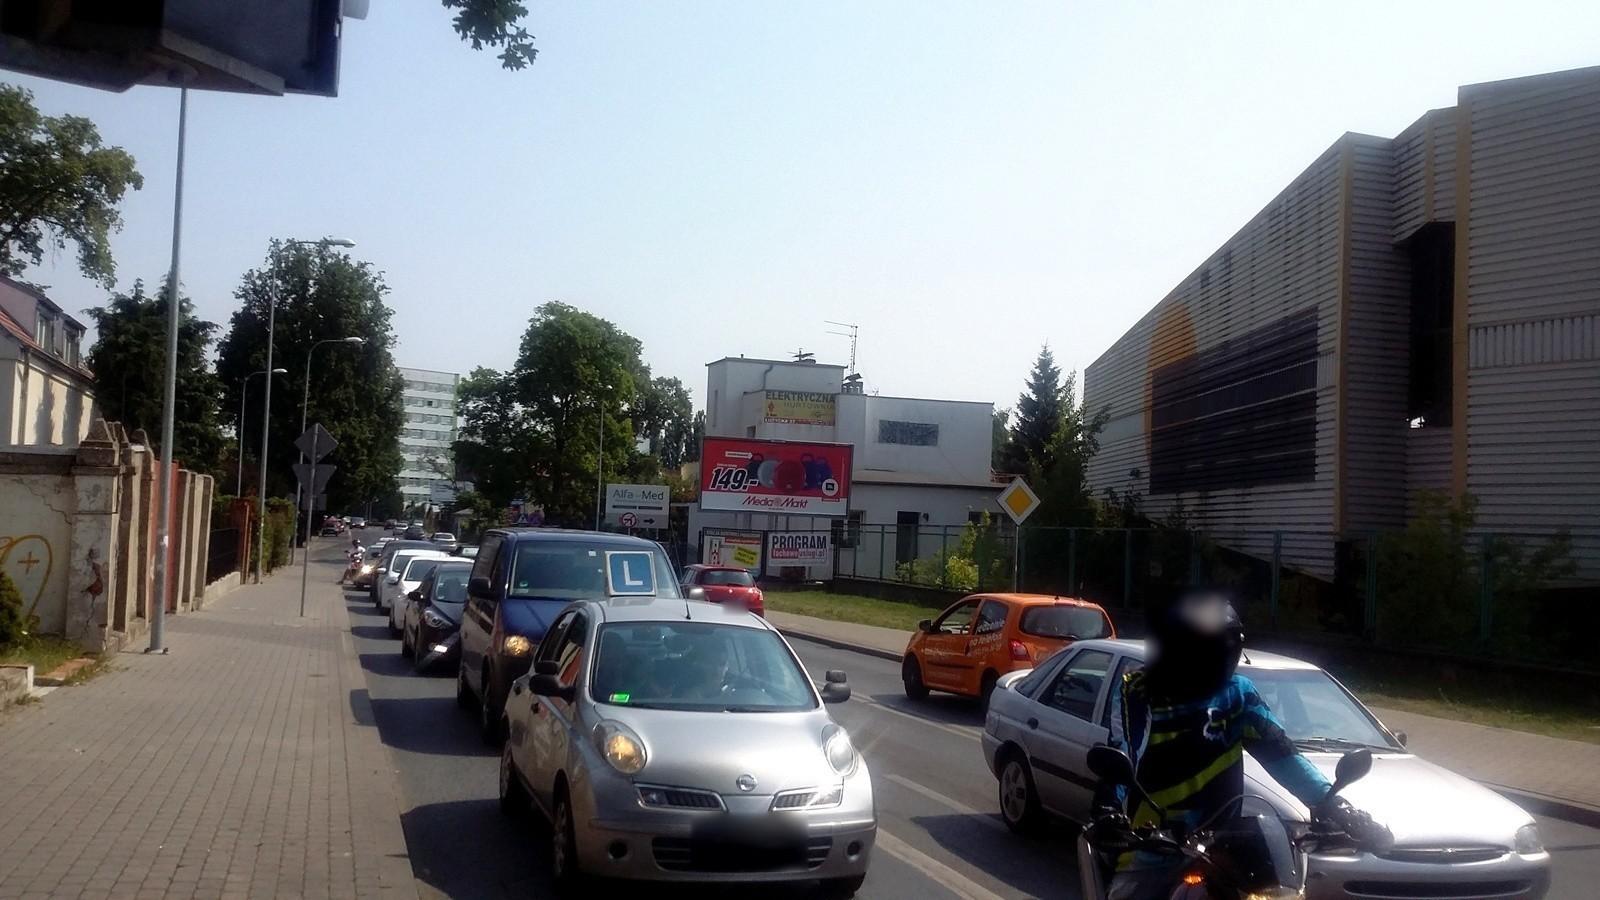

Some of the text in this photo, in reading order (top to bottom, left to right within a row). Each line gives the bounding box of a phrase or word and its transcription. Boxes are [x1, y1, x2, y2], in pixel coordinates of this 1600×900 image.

[766, 391, 835, 403] ELEKTRYCZNA
[772, 535, 827, 549] PROGRAM
[623, 560, 643, 585] L
